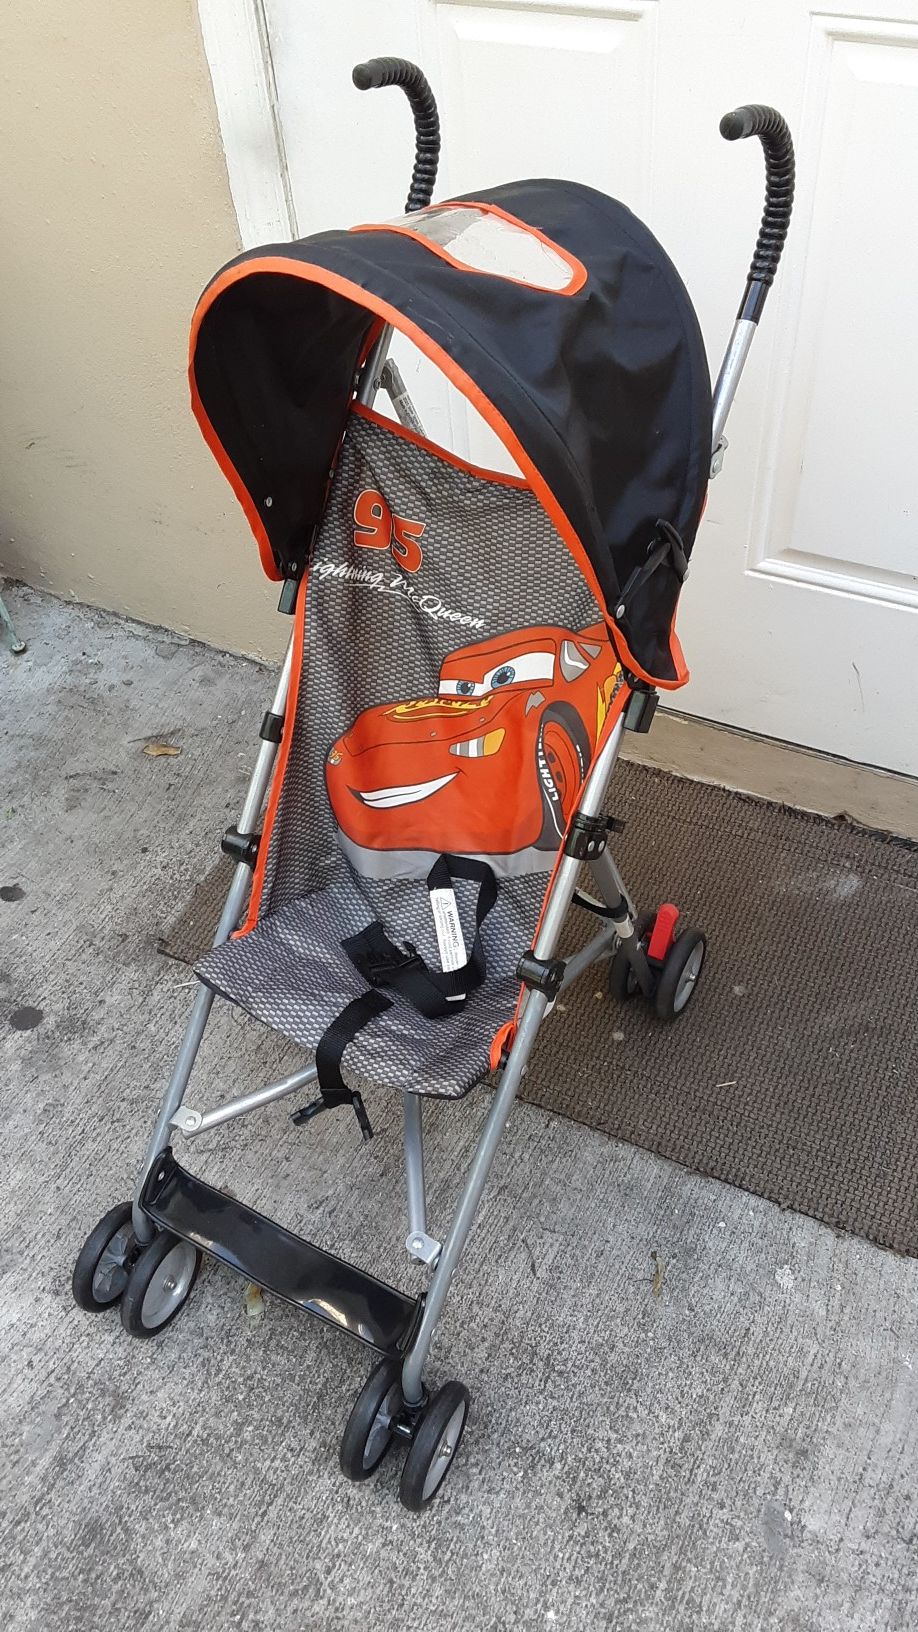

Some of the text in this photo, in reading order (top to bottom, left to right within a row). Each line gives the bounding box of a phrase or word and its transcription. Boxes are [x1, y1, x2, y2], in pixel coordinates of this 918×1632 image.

[353, 489, 427, 574] 95
[310, 558, 488, 629] ightning McQueen
